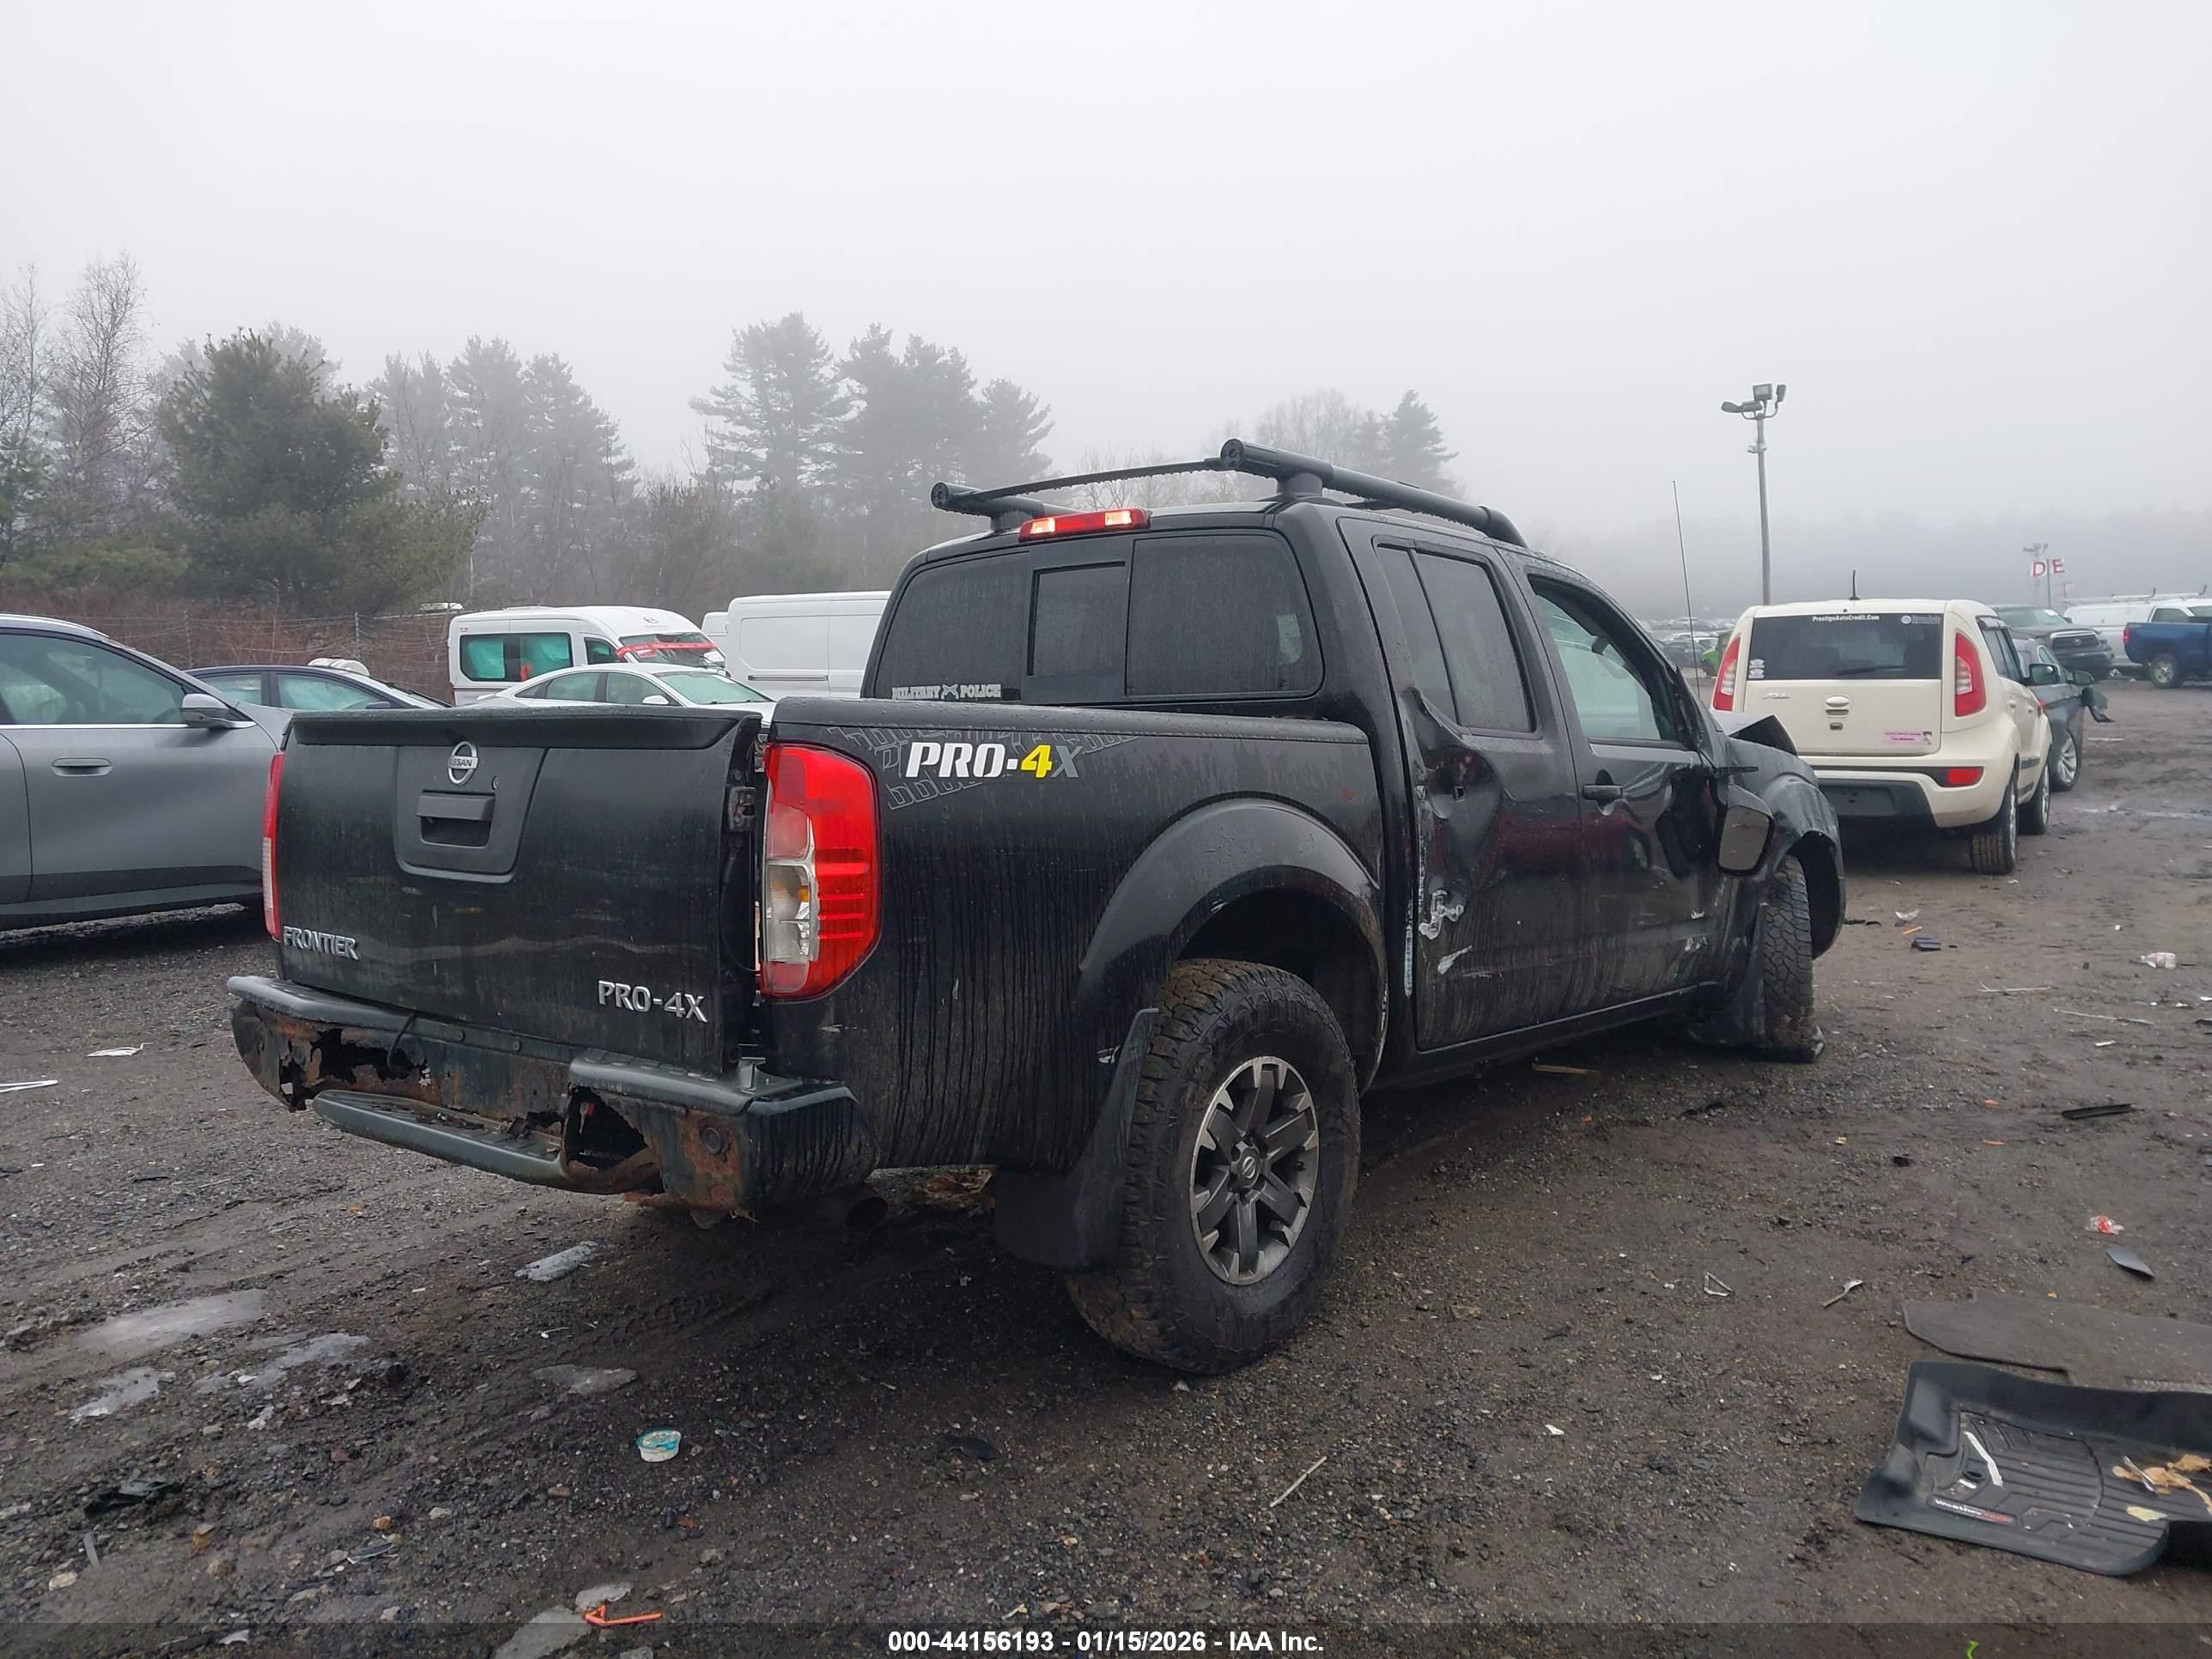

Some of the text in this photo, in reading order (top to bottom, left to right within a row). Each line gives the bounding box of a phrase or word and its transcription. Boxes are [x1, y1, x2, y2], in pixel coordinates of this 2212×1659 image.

[891, 684, 1001, 700] MILITARY POLICE
[283, 926, 359, 960] FRONTIER
[599, 980, 708, 1023] PRO-4X
